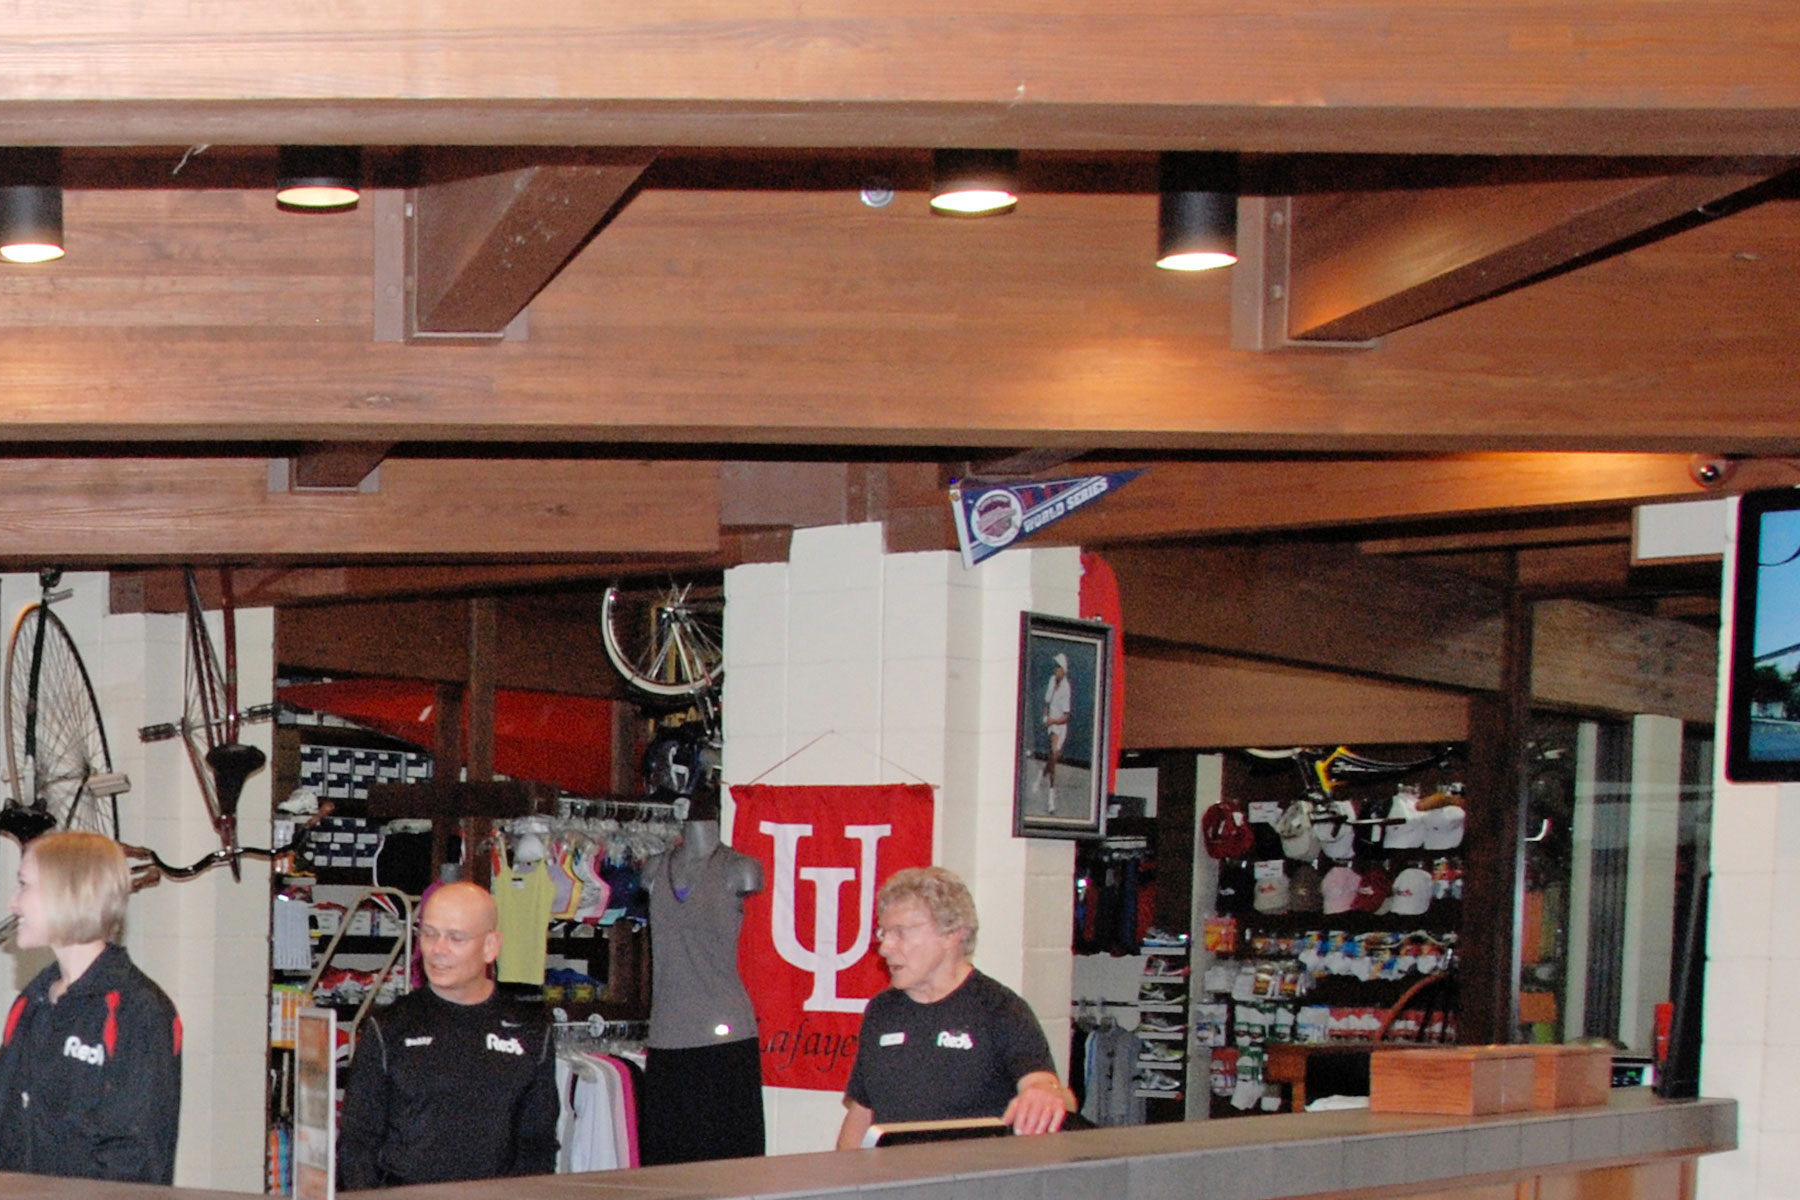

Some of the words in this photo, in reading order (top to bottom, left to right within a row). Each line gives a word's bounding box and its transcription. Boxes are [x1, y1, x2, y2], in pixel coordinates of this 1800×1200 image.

[1023, 501, 1066, 533] WORLD
[1066, 477, 1108, 511] SERIES
[757, 1018, 859, 1073] afaye
